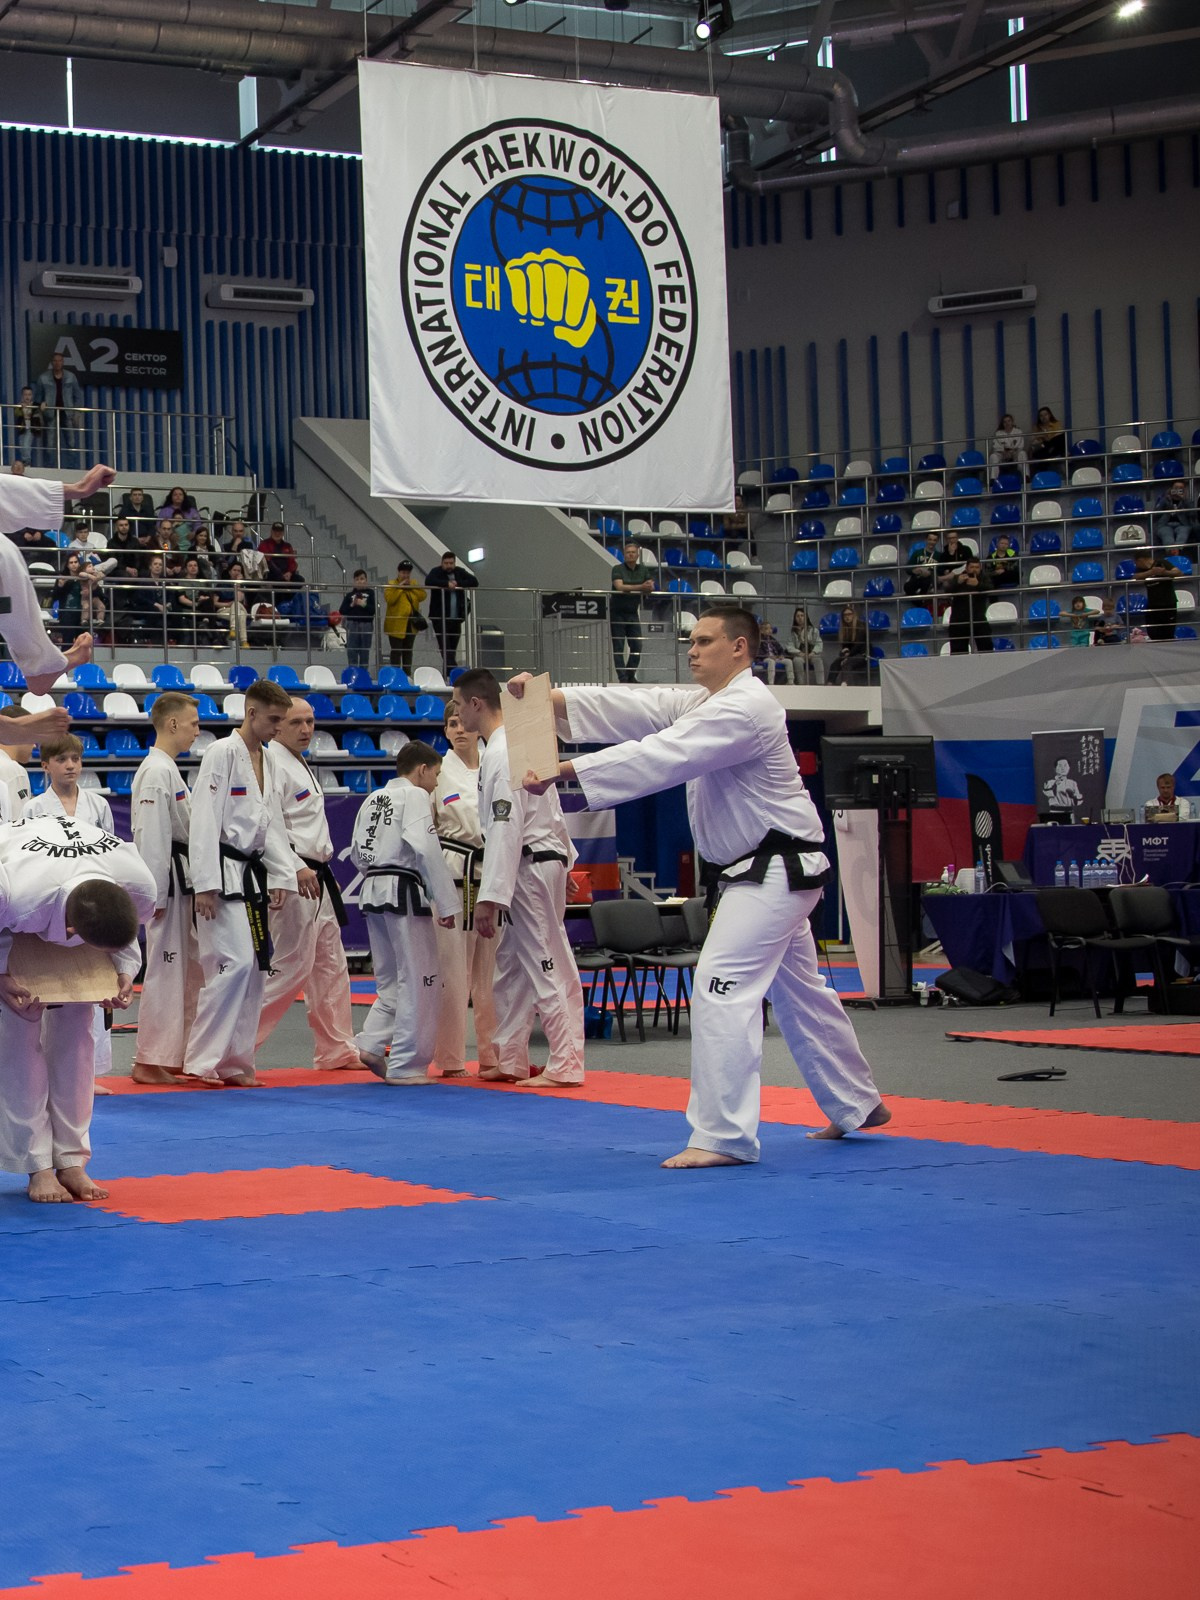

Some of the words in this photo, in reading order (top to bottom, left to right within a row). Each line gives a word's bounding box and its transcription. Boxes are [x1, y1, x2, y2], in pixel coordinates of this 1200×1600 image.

[461, 132, 668, 247] TAEKWON-DO
[124, 365, 167, 376] SECTOR
[413, 179, 537, 452] INTERNATIONAL
[577, 260, 687, 456] FEDERATION
[1142, 837, 1169, 846] МФТ
